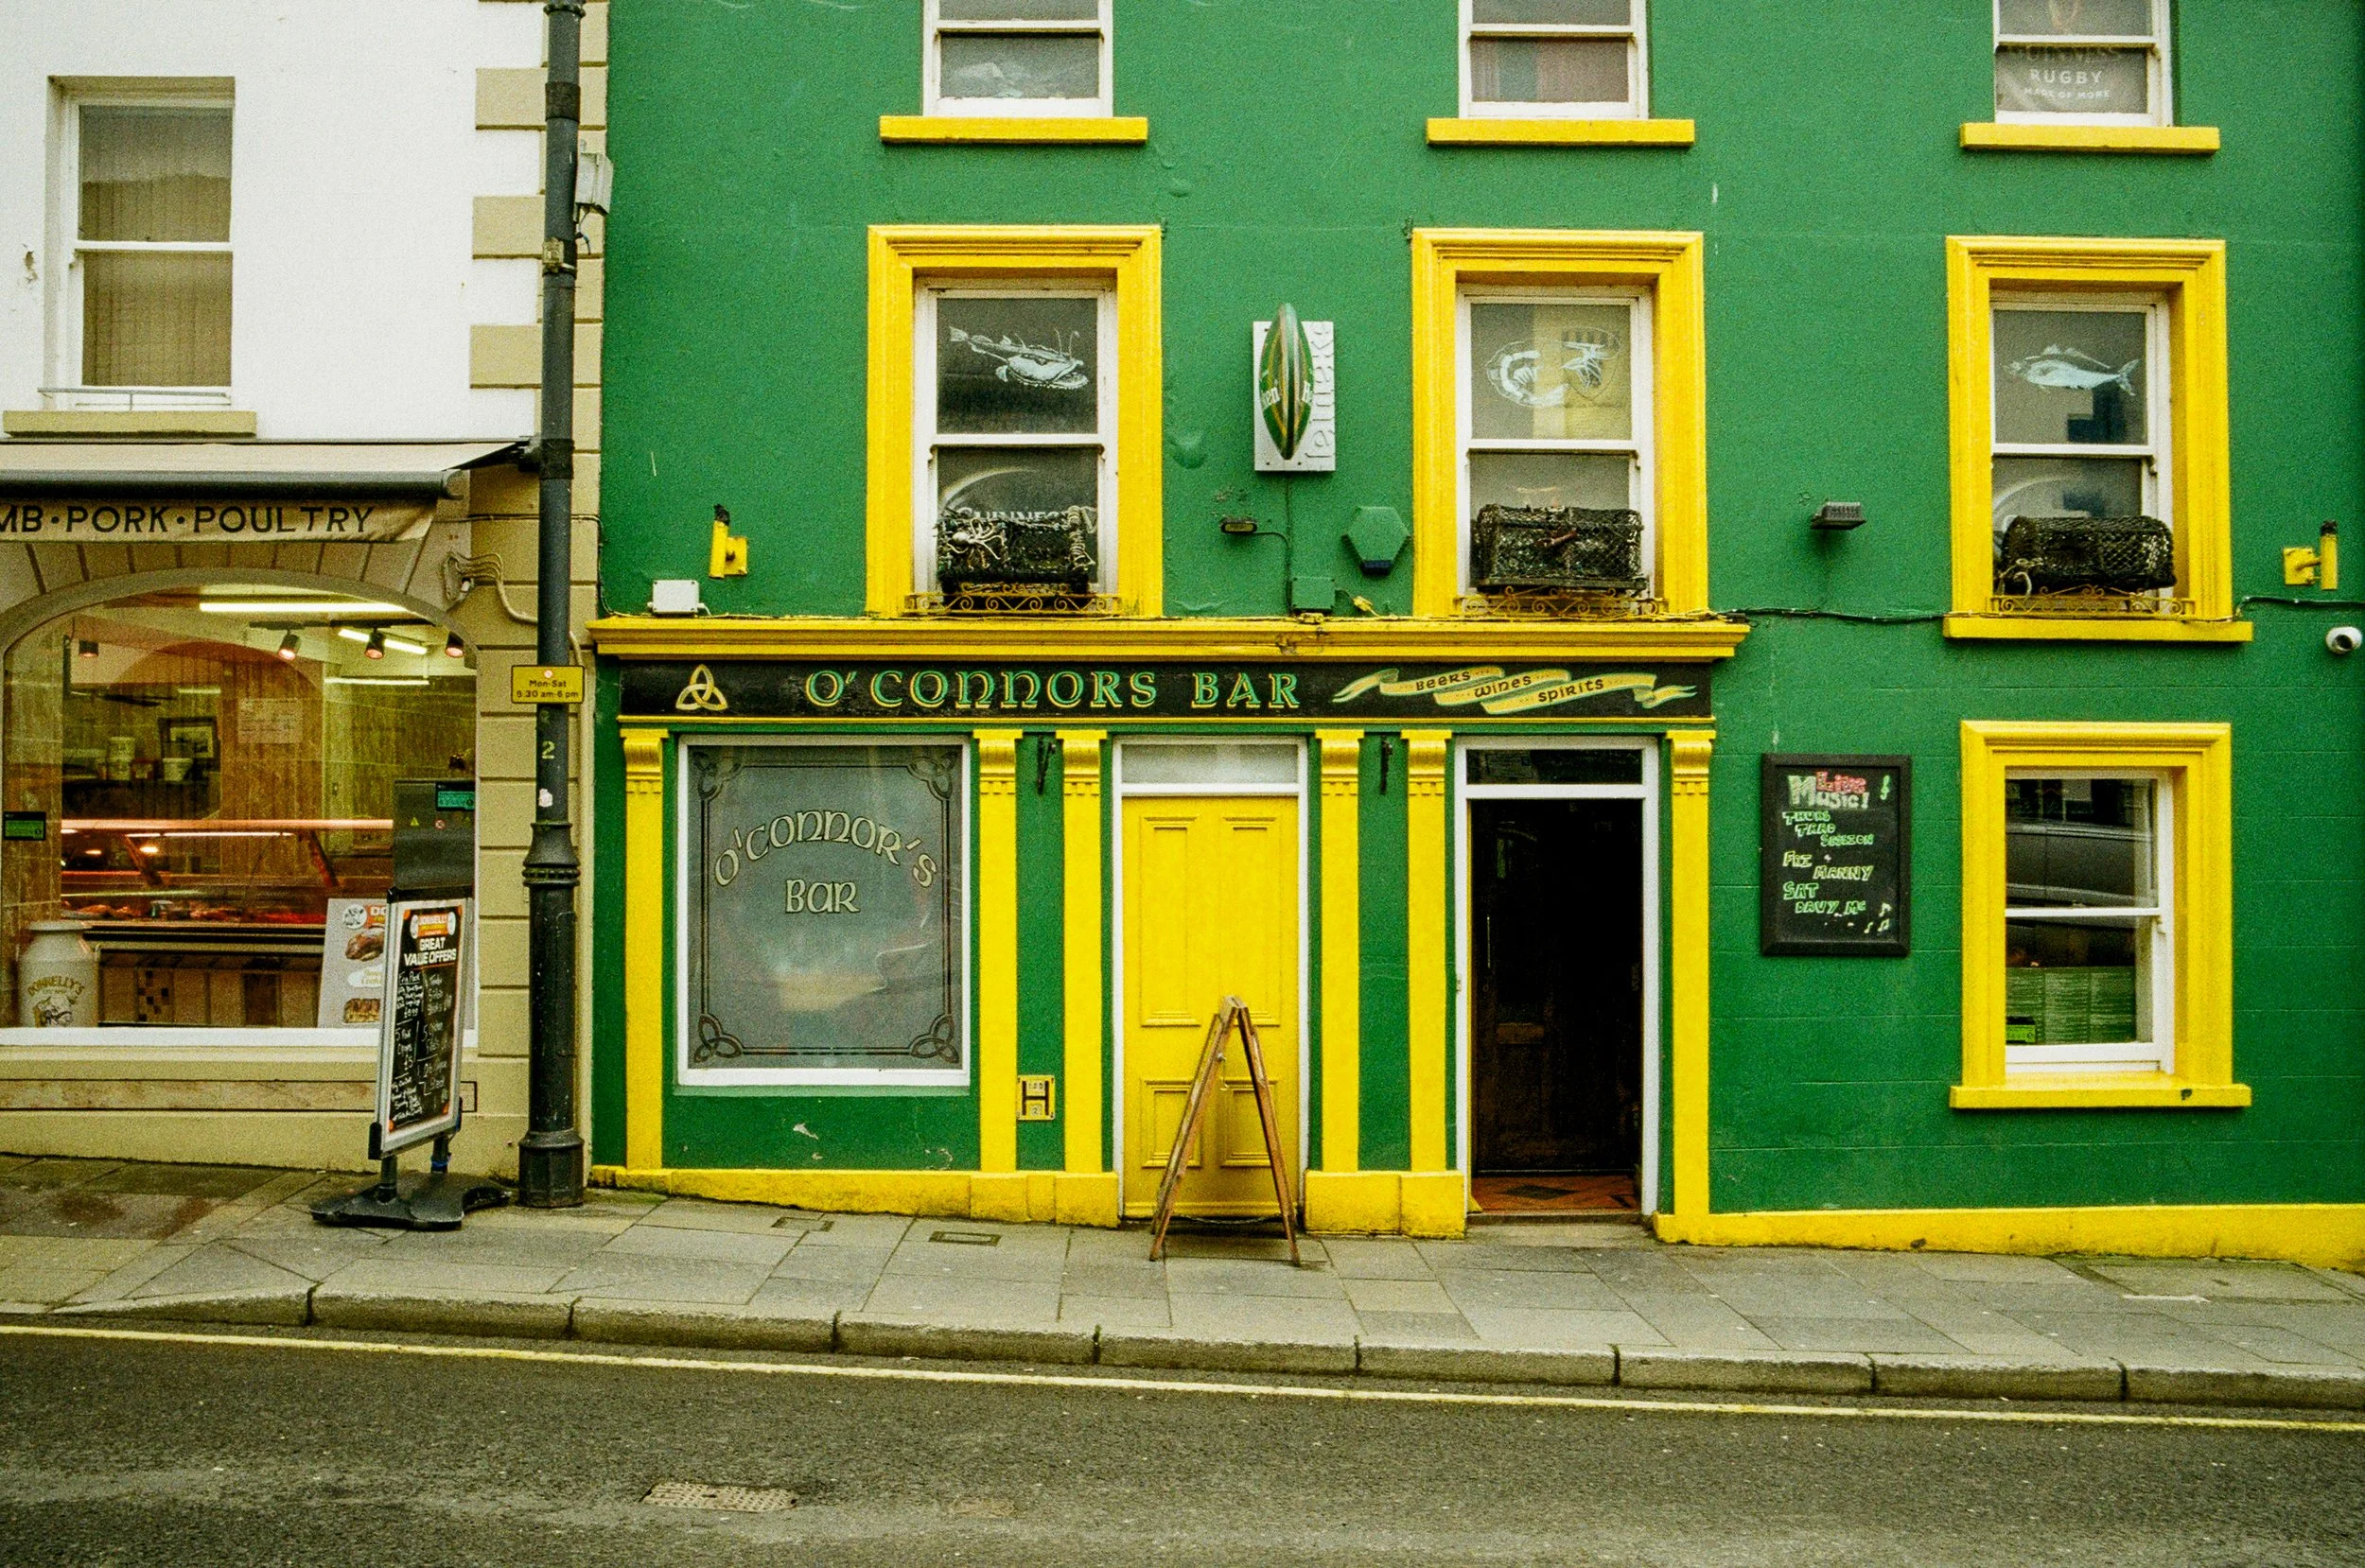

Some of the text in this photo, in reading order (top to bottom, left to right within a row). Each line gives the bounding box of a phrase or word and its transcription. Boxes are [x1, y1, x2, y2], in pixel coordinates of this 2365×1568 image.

[2029, 68, 2103, 84] RUGBY
[65, 506, 168, 532] PORK
[193, 506, 376, 532] POULTRY
[1191, 672, 1300, 708] BAR
[542, 740, 556, 759] 2
[1787, 775, 1870, 810] Music!
[1795, 823, 1836, 837] TRAD
[1782, 850, 1813, 868] FRI
[1813, 865, 1874, 881] MANNY
[1782, 881, 1819, 900] SAT
[1795, 900, 1840, 915] DAVY
[419, 936, 446, 951] GREAT
[404, 949, 457, 966] VALUE OFFERS
[1022, 1080, 1049, 1116] H
